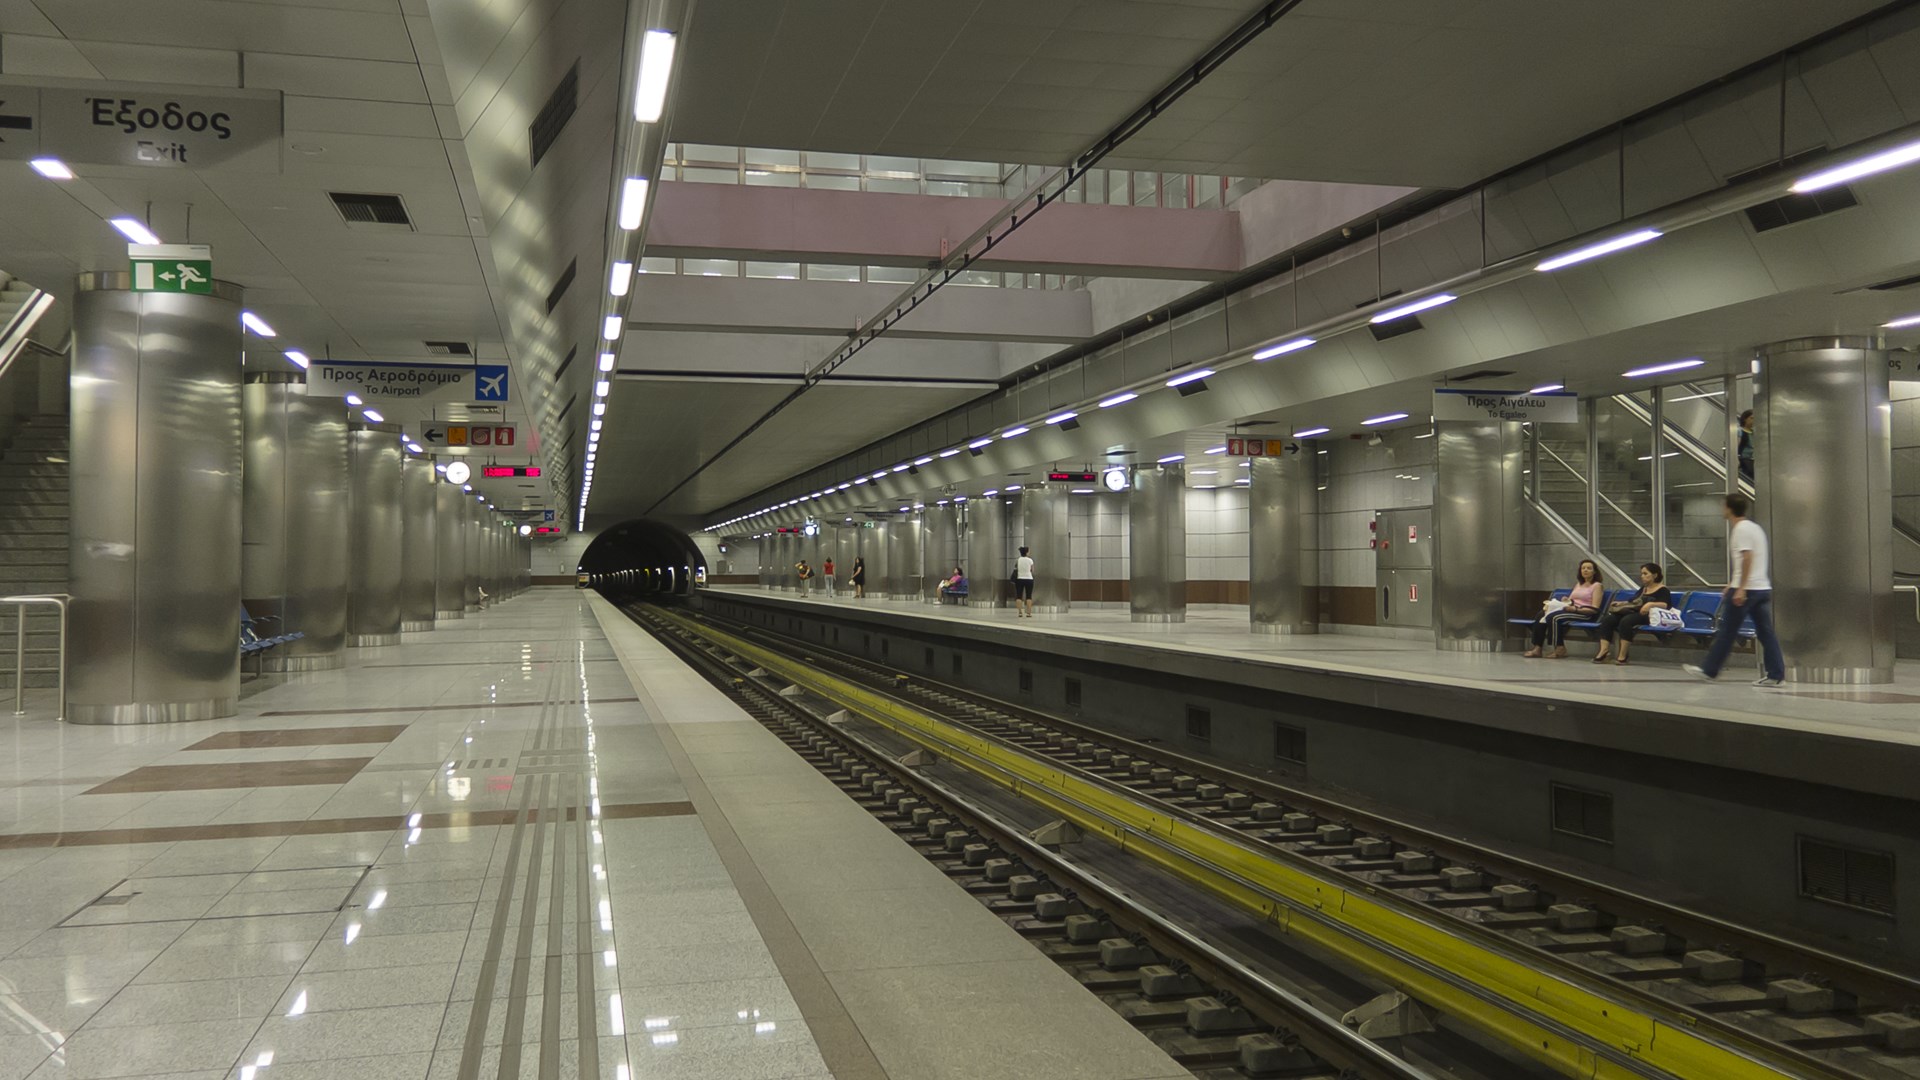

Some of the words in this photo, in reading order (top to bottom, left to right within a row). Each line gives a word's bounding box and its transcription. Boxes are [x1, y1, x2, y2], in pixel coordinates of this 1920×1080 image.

[85, 97, 231, 139] Έξοδος
[137, 140, 187, 163] Exit
[323, 367, 363, 383] Προς
[367, 368, 461, 385] Αεροδρόμιο
[365, 385, 378, 394] To
[381, 386, 420, 396] Airport
[1467, 396, 1497, 408] Προς
[1500, 396, 1546, 409] Αιγάλεω
[1488, 410, 1498, 418] To
